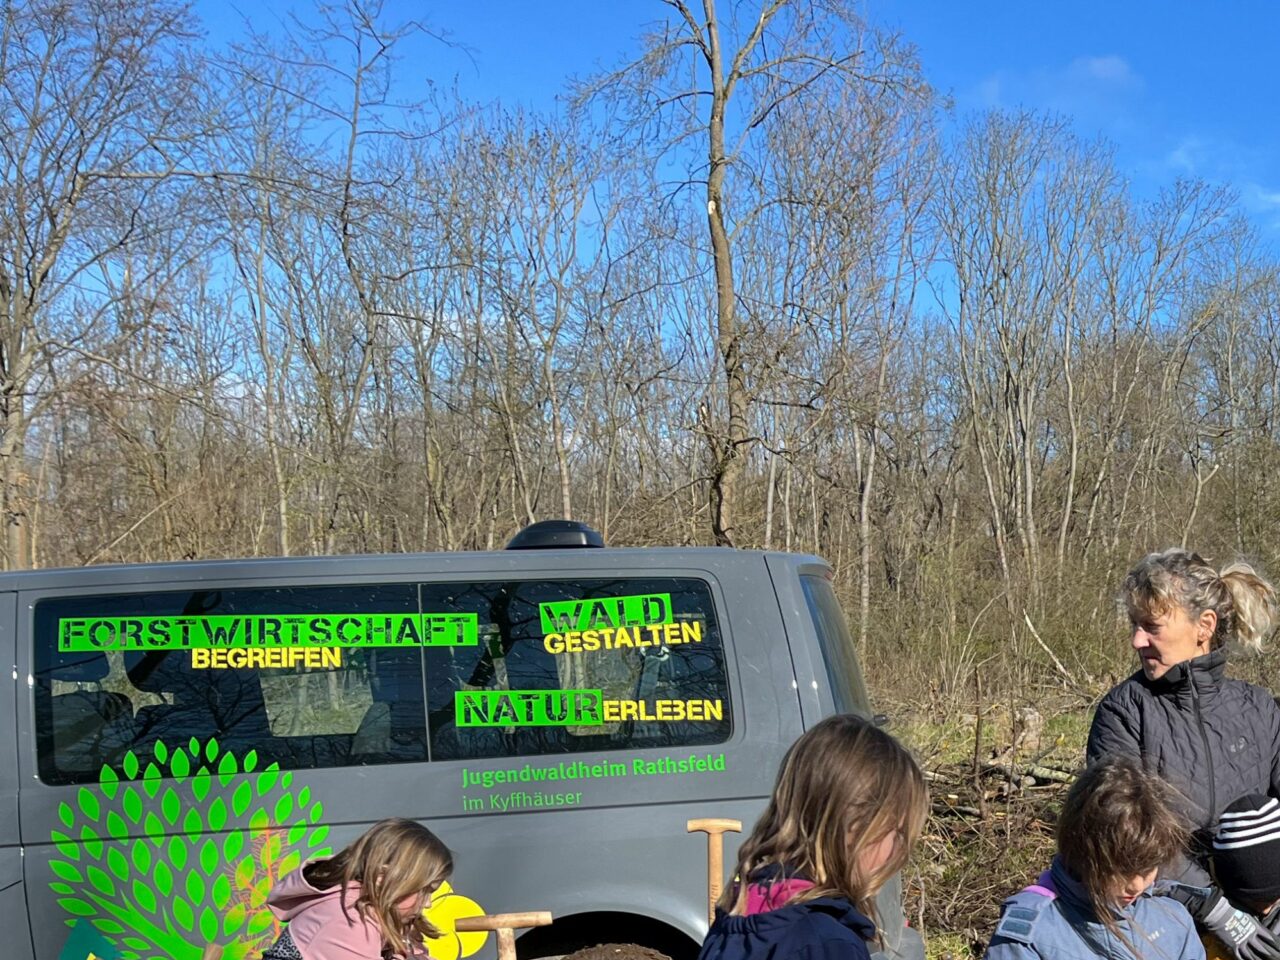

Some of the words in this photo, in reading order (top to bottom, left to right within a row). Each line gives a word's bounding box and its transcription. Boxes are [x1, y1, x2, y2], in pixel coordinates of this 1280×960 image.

[543, 596, 666, 631] WALD
[62, 617, 471, 648] FORSTWIRTSCHAFT
[544, 621, 702, 654] GESTALTEN
[191, 646, 341, 669] BEGREIFEN
[463, 692, 600, 724] NATUR
[462, 761, 627, 788] Jugendwaldheim
[632, 754, 726, 775] Rathsfeld
[463, 795, 483, 811] im
[490, 791, 582, 812] Kyffhäuser
